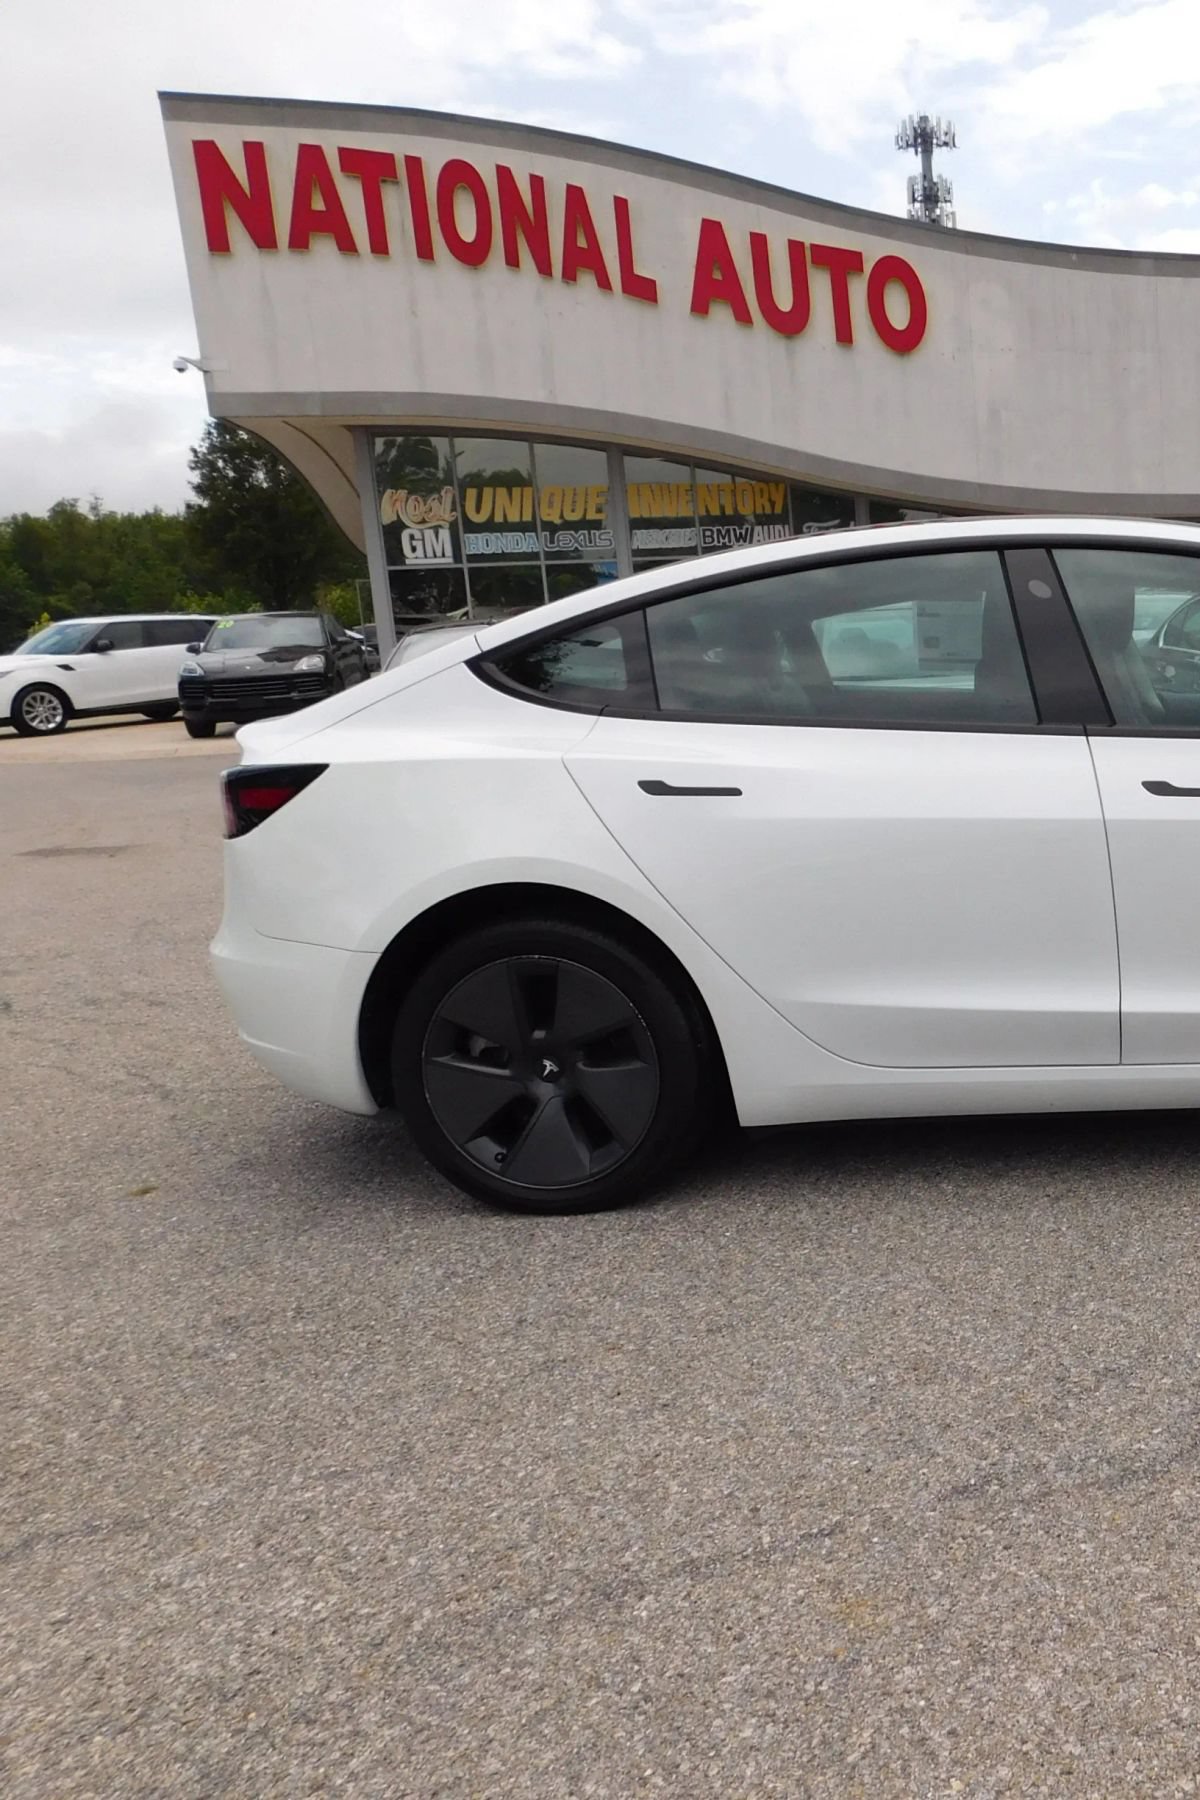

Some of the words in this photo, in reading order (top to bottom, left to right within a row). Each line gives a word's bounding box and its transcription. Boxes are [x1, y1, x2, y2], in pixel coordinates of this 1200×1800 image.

[193, 141, 656, 303] NATIONAL
[692, 219, 927, 352] AUTO
[465, 485, 608, 524] UNIQUE
[627, 482, 786, 518] INVENTORY
[401, 528, 454, 565] GM
[464, 532, 541, 555] HONDA
[543, 530, 615, 551] LEXUS
[701, 525, 751, 547] BMW
